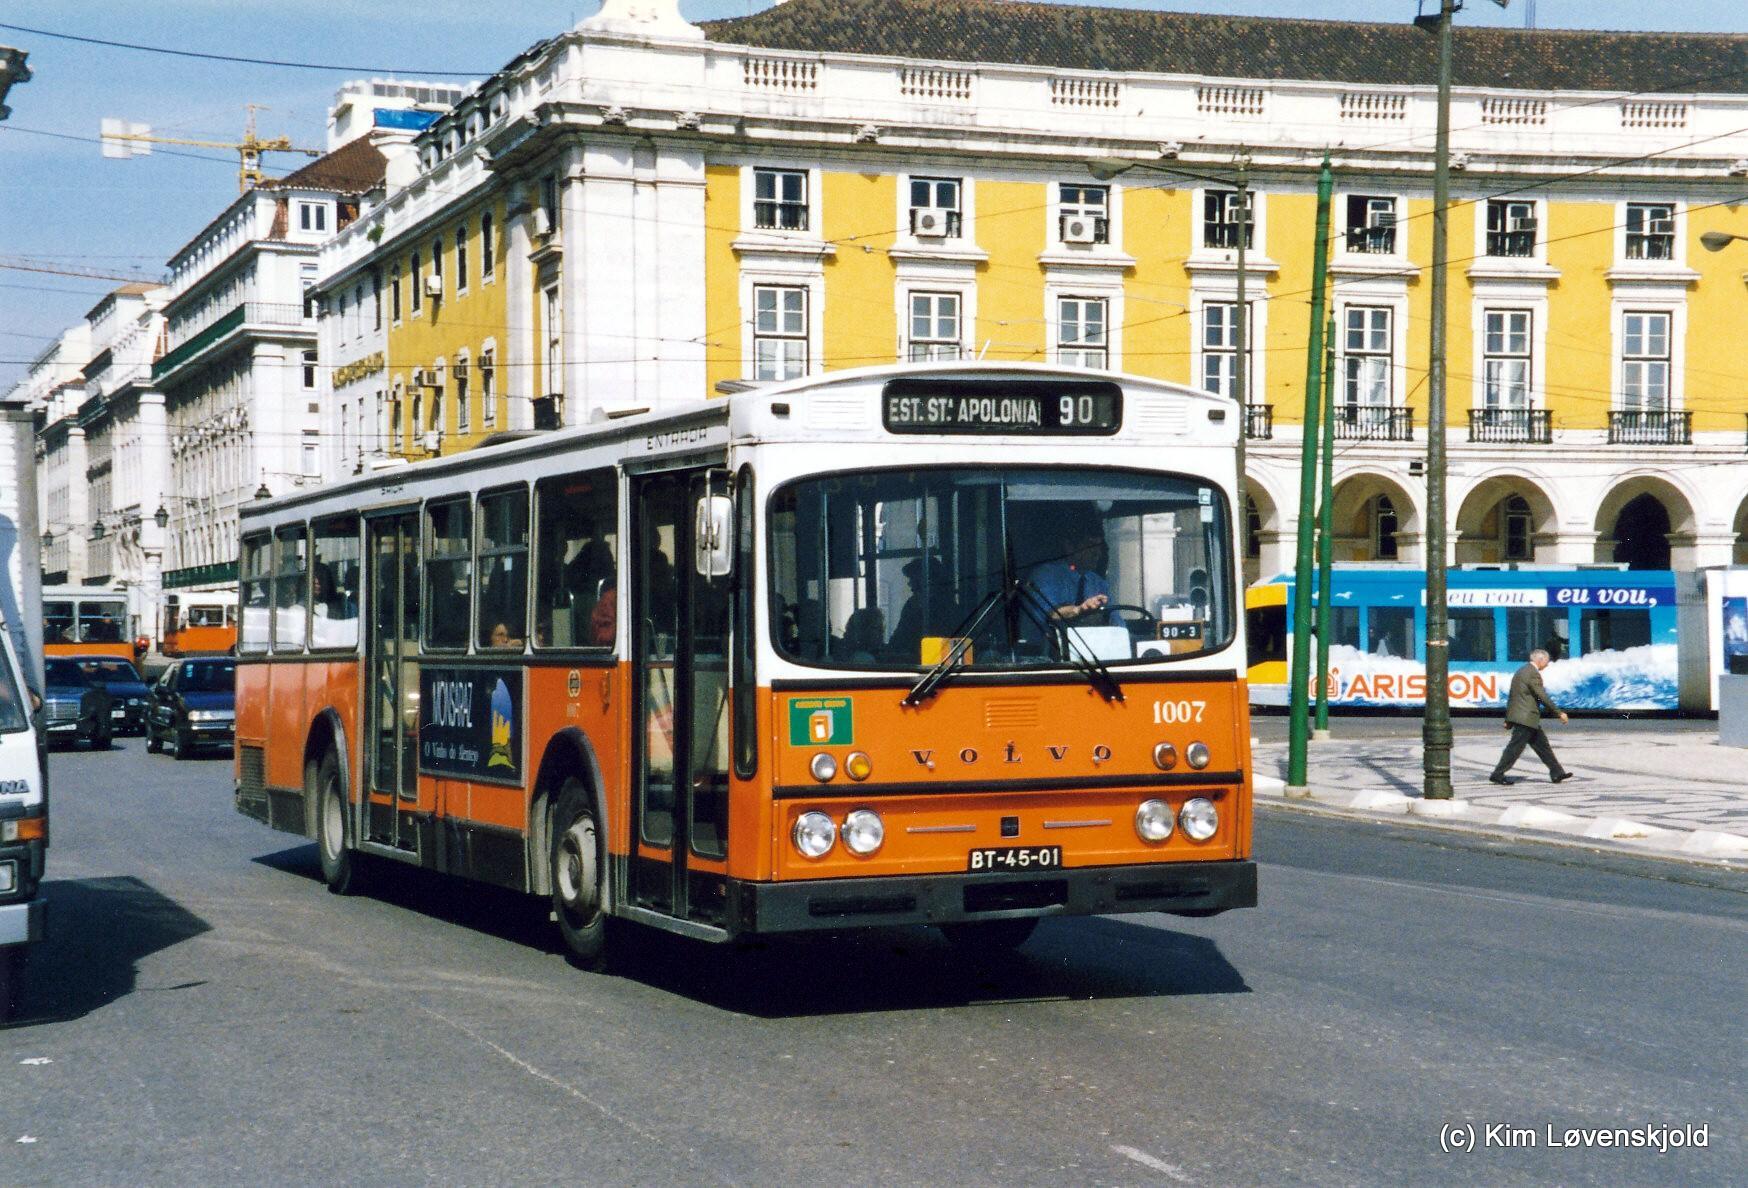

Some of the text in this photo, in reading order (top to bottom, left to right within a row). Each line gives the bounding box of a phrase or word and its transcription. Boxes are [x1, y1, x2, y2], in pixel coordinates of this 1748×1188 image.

[888, 397, 924, 422] EST.
[958, 398, 1039, 424] APOLONIA
[1059, 395, 1093, 424] 90
[1448, 592, 1534, 605] eu vou.
[1556, 587, 1658, 608] eu vou,
[1346, 673, 1497, 699] ARISON
[1153, 700, 1206, 724] 1007
[911, 744, 1112, 767] VOLVO
[971, 848, 1059, 869] BT-45-01
